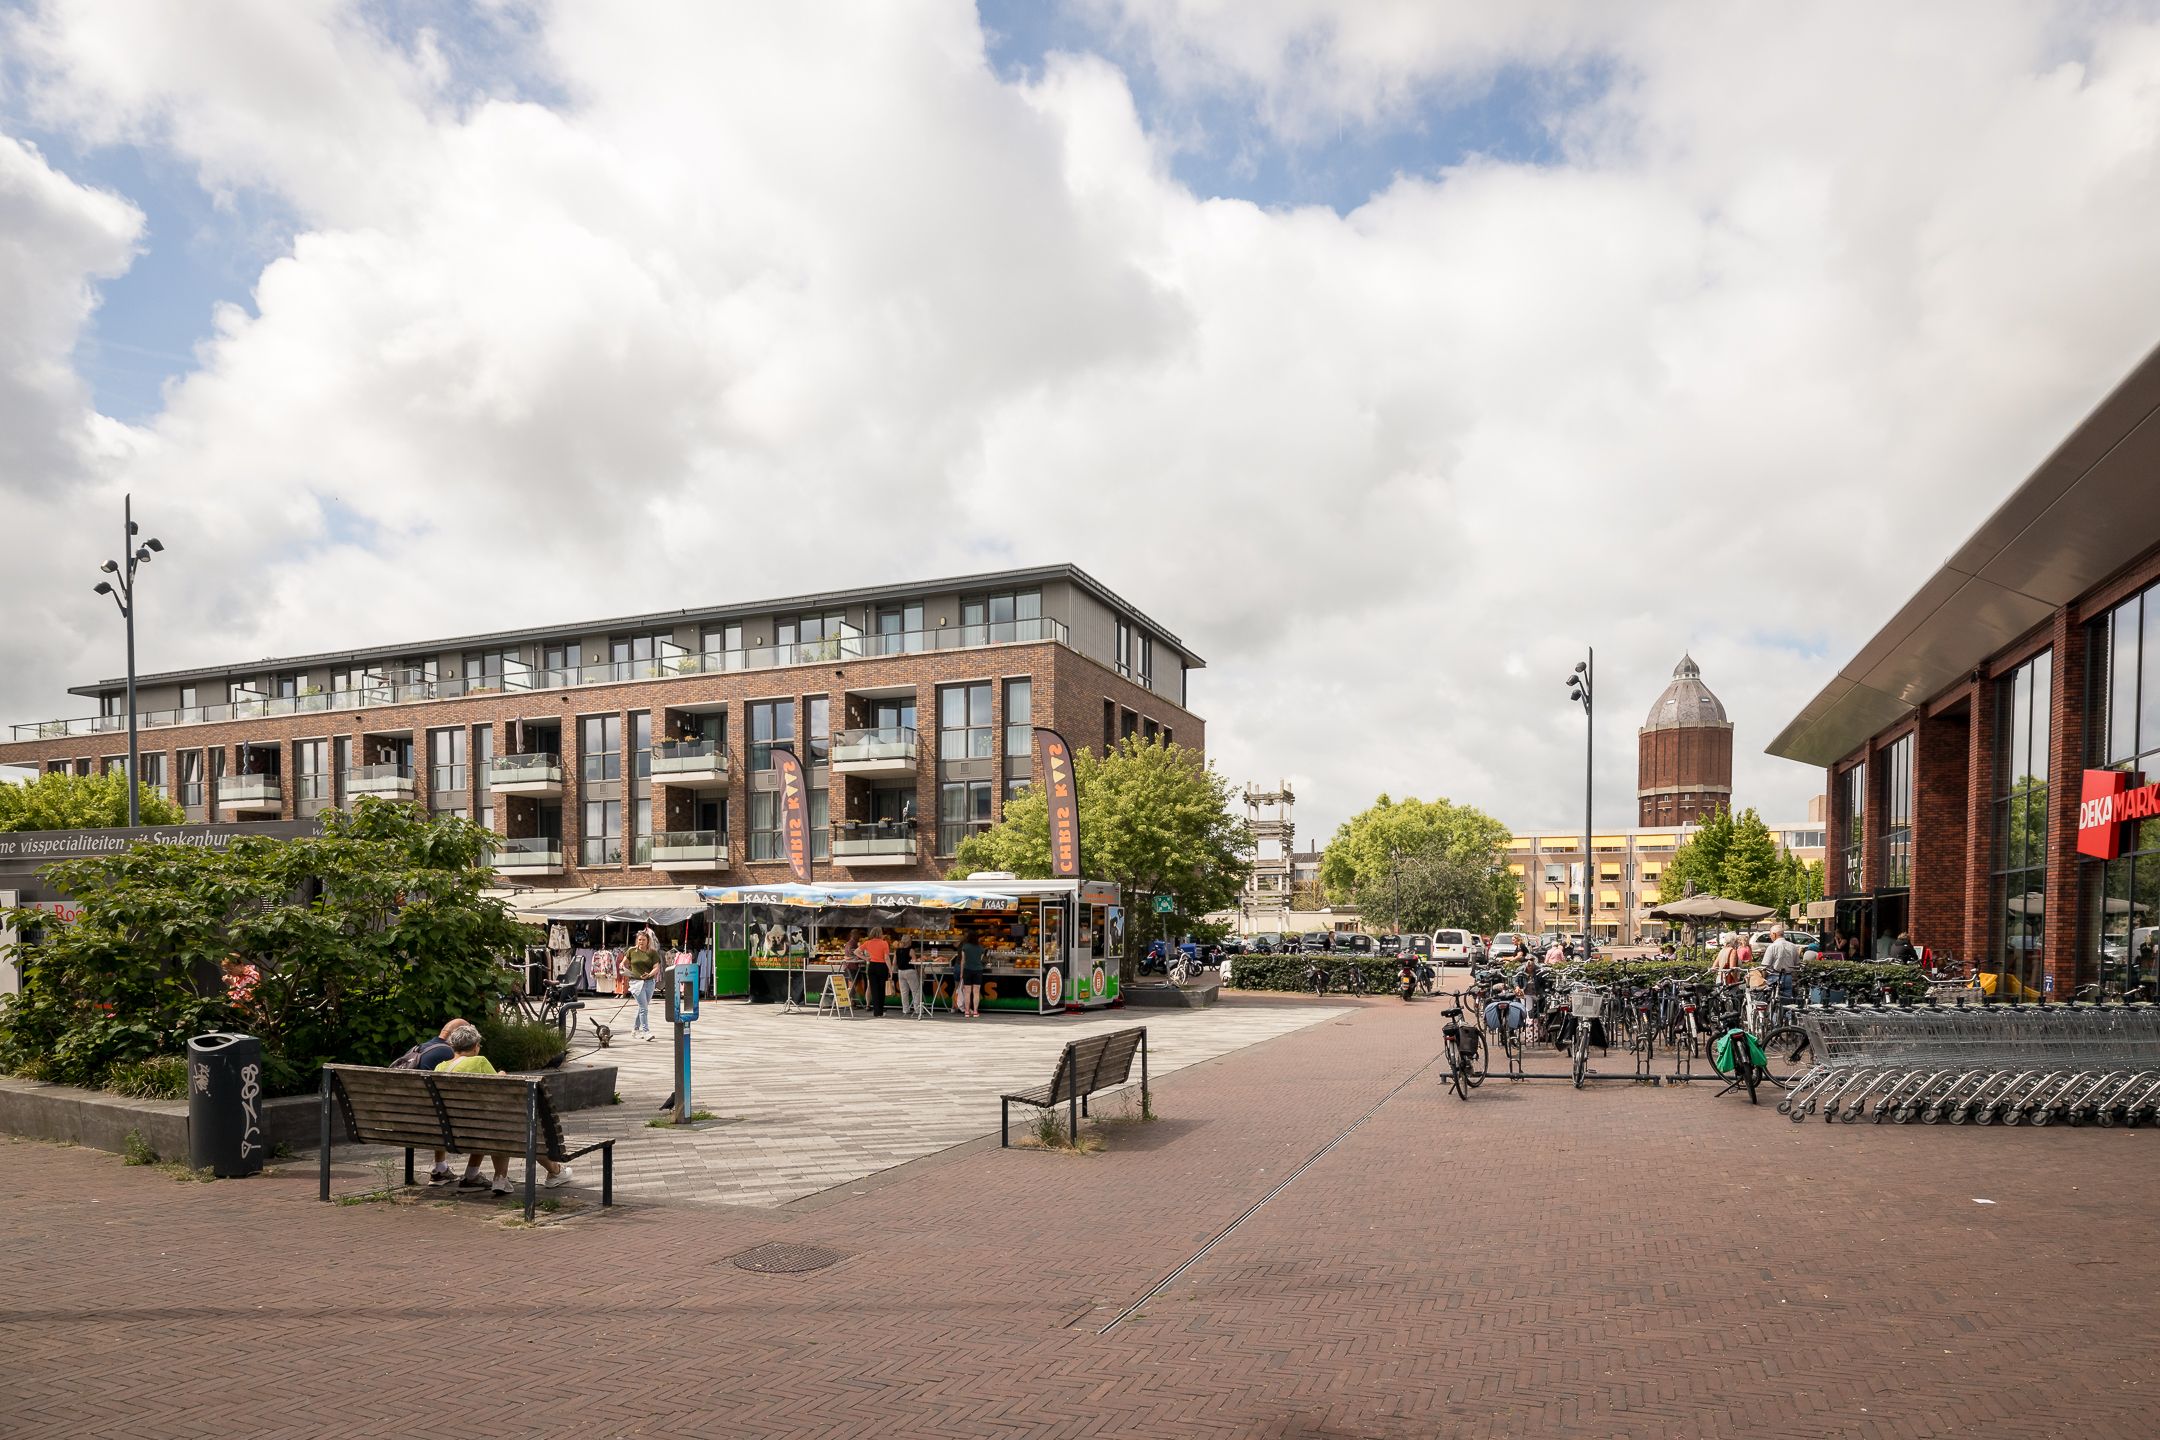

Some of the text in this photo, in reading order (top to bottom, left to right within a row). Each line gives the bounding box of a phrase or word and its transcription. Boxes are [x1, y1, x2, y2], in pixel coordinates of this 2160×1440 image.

[21, 835, 125, 855] visspecialiteiten
[153, 829, 240, 847] Spakenbur
[743, 893, 778, 904] KAAS
[876, 896, 914, 906] KAAS
[985, 900, 1006, 910] KAAS
